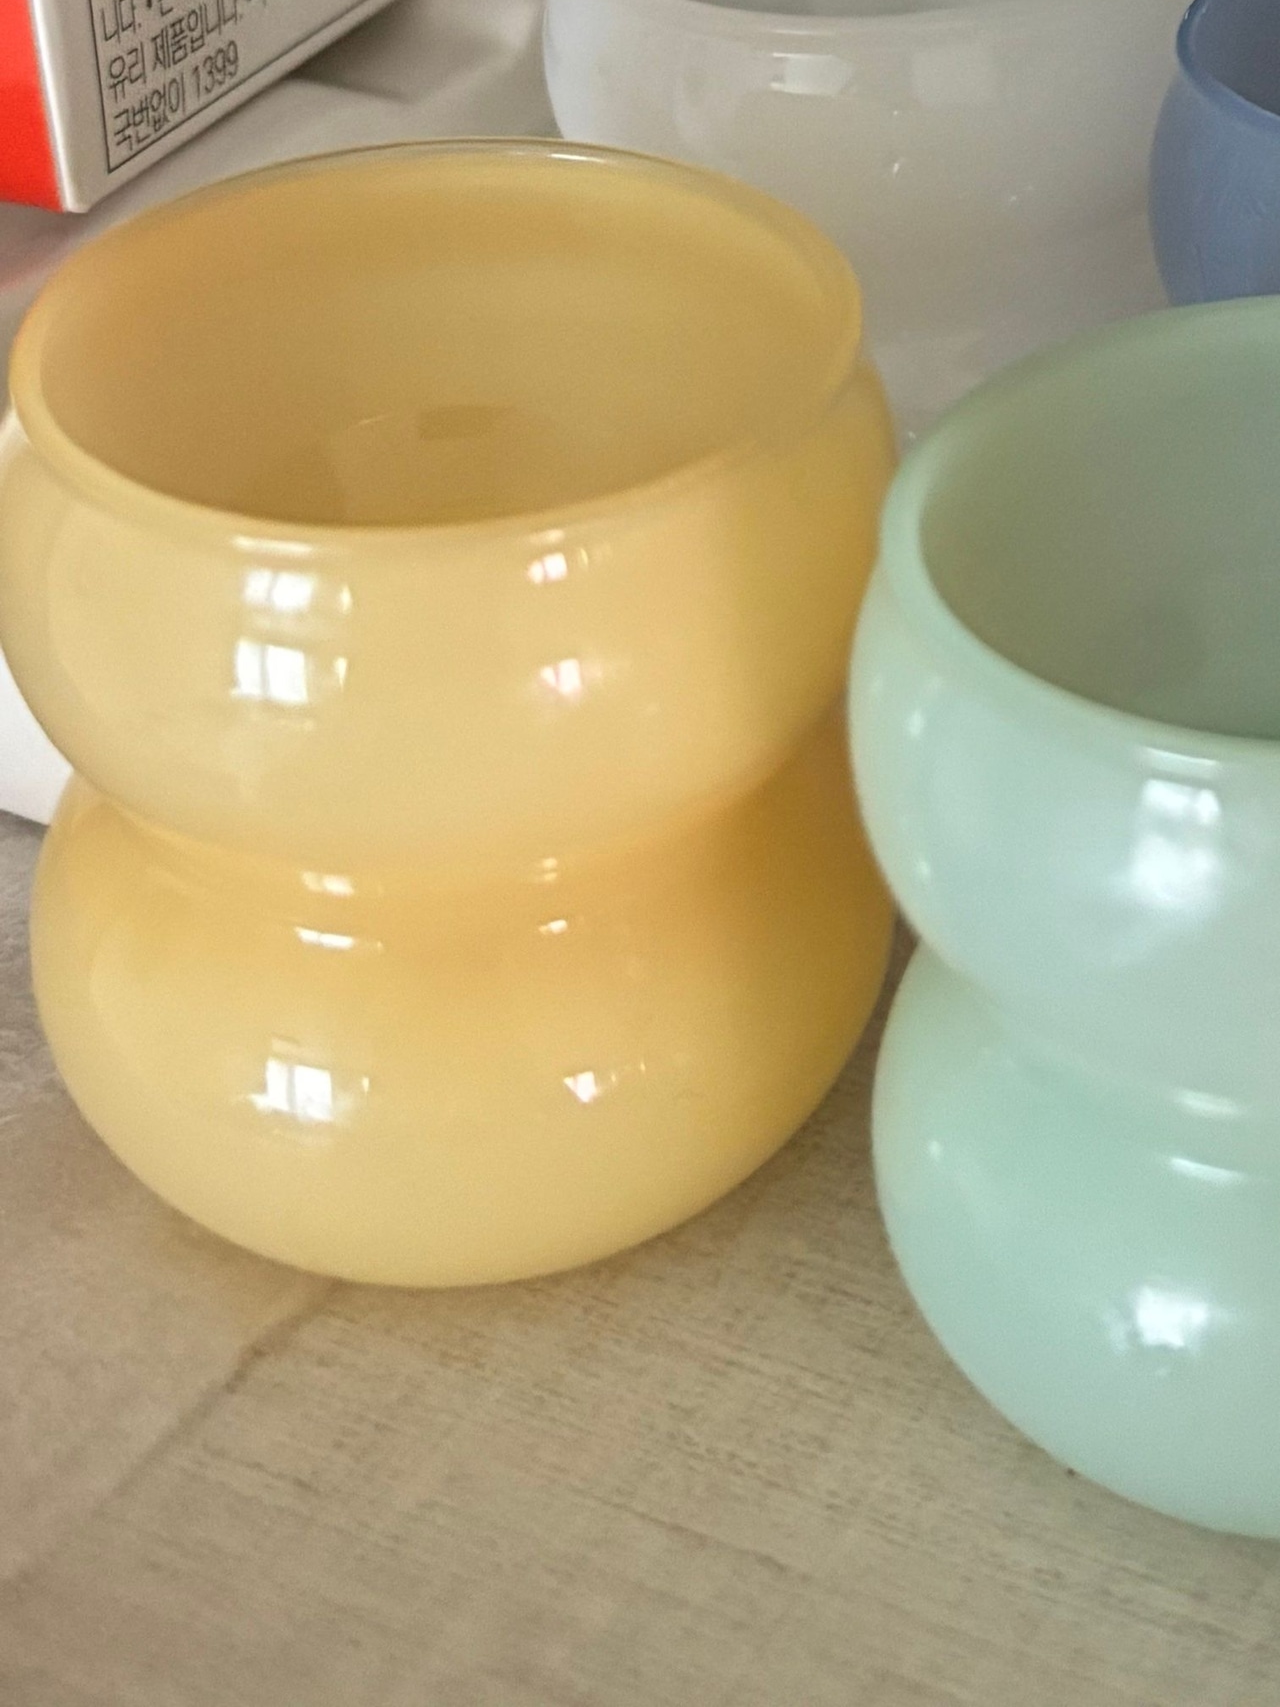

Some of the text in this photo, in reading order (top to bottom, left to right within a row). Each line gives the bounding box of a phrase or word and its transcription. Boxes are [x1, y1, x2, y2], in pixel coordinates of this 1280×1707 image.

[107, 42, 148, 104] 유리
[113, 39, 240, 151] 국번없이 1399
